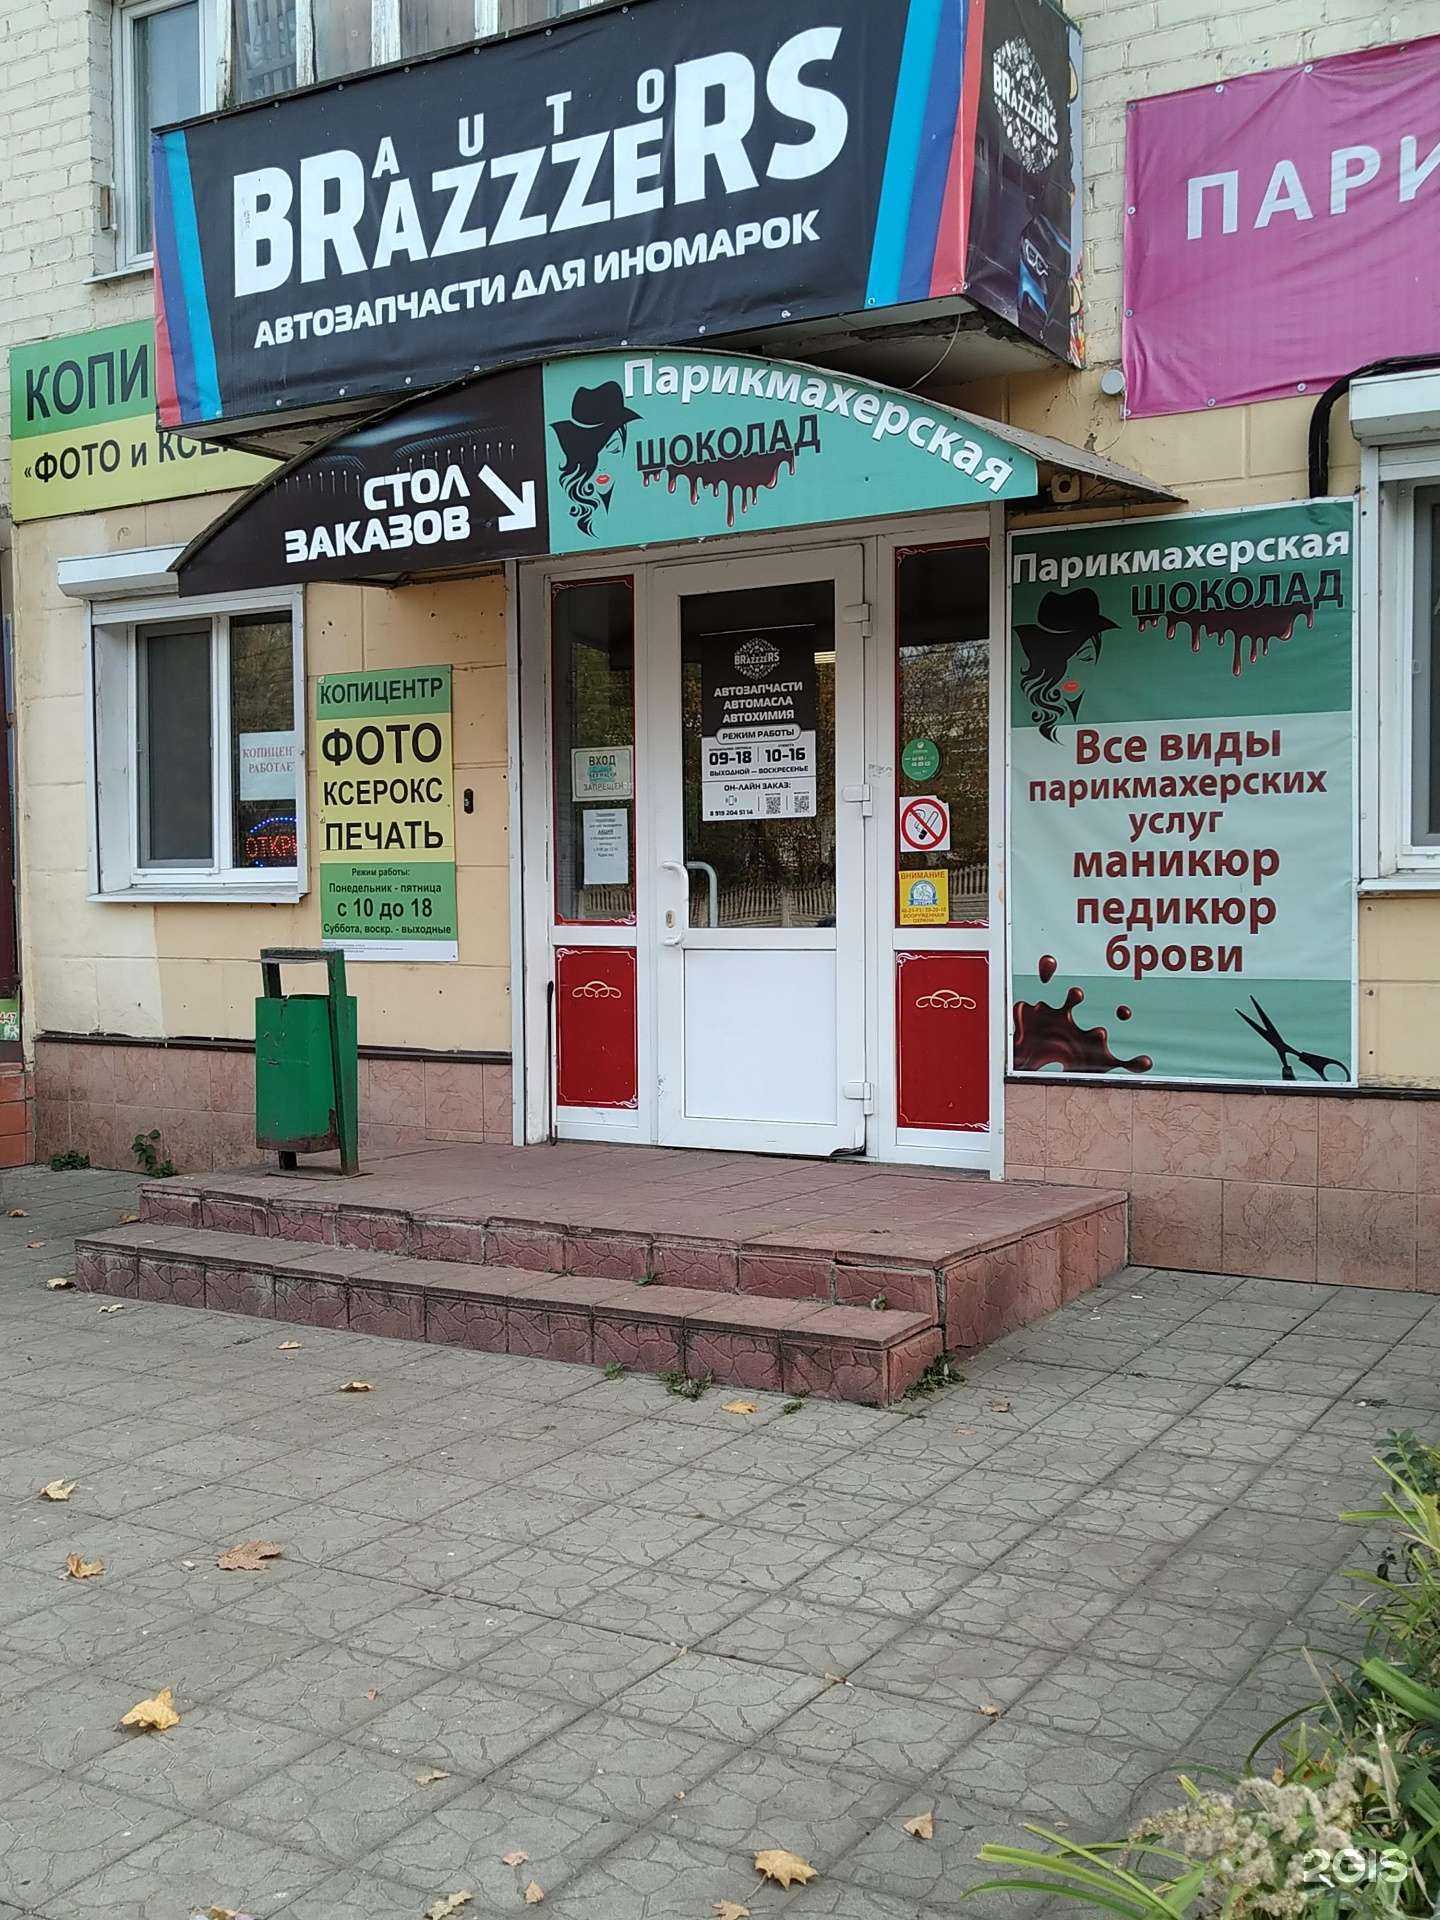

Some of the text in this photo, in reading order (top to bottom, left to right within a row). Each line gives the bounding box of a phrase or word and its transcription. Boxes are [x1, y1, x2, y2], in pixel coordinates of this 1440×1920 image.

[993, 61, 1058, 146] BRAZZZERS
[233, 26, 849, 298] BRAZZZERS
[1187, 135, 1440, 240] ПАРИ
[253, 208, 821, 349] АВТОЗАПЧАСТИ ДЛЯ ИНОМАРОК
[26, 344, 149, 422] КОПИ
[624, 357, 1014, 494] Парикмахерская
[635, 414, 821, 473] ШОКОЛАД
[24, 439, 121, 483] «ФОТО
[131, 442, 147, 467] и
[363, 464, 471, 511] СТОЛ
[284, 505, 471, 564] ЗАКАЗОВ
[1012, 530, 1351, 588] Парикмахерская
[1131, 568, 1344, 617] ШОКОЛАД
[320, 677, 443, 704] КОПИЦЕНТР
[713, 681, 803, 697] АВТОЗАПЧАСТИ
[723, 696, 794, 710] АВТОМАСЛА
[722, 709, 795, 723] АВТОХИМИЯ
[322, 722, 442, 766] ФОТО
[722, 729, 795, 740] РЕЖИМ РАБОТЫ
[1075, 728, 1281, 767] Все виды
[242, 746, 296, 759] КОПИЦЕН
[248, 761, 296, 773] РАБОТАЕ
[589, 755, 616, 768] ВХОД
[709, 750, 752, 765] 09-18
[765, 747, 806, 763] 10-16
[709, 767, 750, 777] ВЫХОДНОЙ
[758, 765, 809, 775] ВОСКРЕСЕНЬЕ
[323, 777, 443, 806] КСЕРОКС
[723, 781, 792, 792] ОН-ЛАЙН ЗАКАЗ:
[1029, 770, 1328, 808] парикмахерских
[325, 821, 444, 850] ПЕЧАТЬ
[1128, 810, 1224, 842] услуг
[351, 867, 411, 878] Режим работы:
[901, 871, 945, 879] ВНИМАНИЕ
[1073, 848, 1280, 886] маникюр
[329, 882, 393, 893] Понедельник
[400, 883, 442, 893] пятница
[337, 897, 433, 920] с 10 до 18
[1076, 896, 1277, 934] педикюр
[323, 923, 362, 935] Суббота,
[364, 924, 393, 934] воскр.
[401, 924, 452, 934] выходные
[1105, 934, 1243, 980] брови
